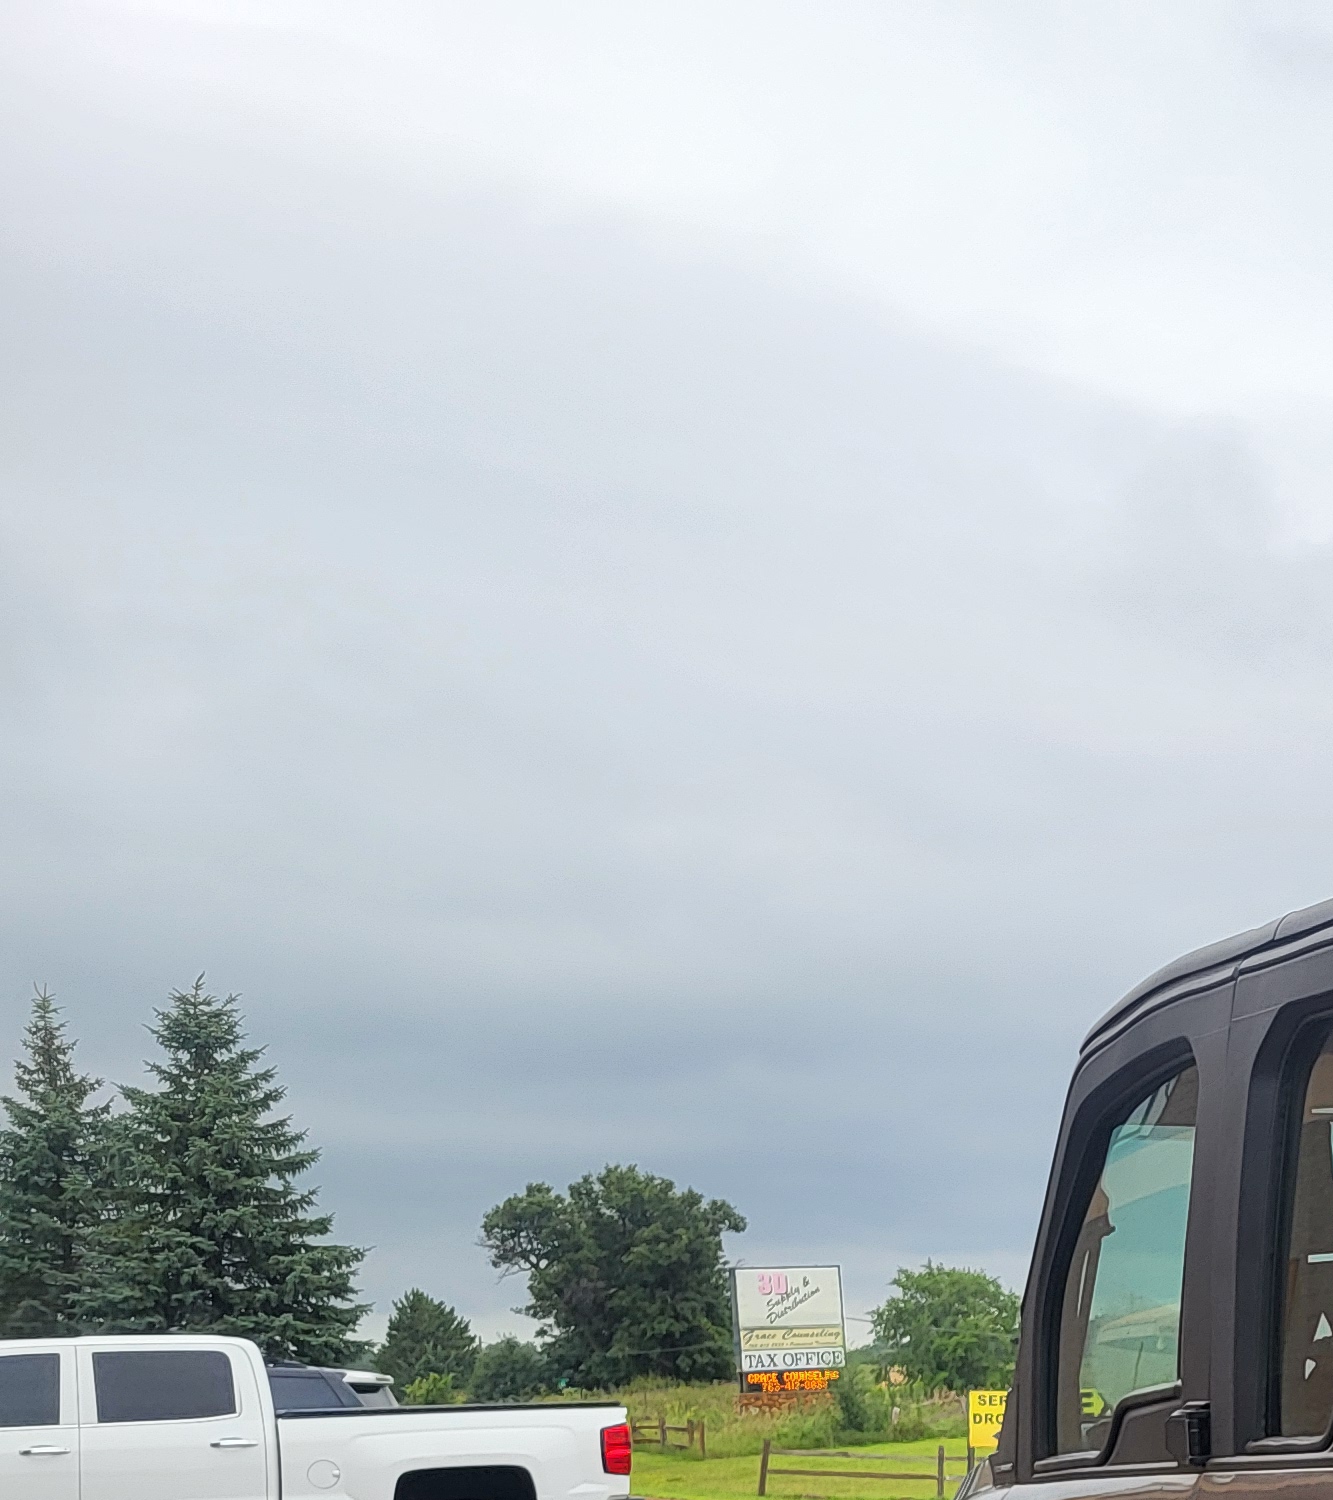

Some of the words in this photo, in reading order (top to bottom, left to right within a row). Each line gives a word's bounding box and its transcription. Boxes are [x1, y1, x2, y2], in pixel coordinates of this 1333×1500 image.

[766, 1286, 801, 1312] Supply
[766, 1287, 821, 1325] Distribution
[743, 1330, 777, 1345] Grace
[782, 1328, 841, 1341] Counseling
[745, 1353, 778, 1369] TAX
[783, 1351, 843, 1367] OFFICE
